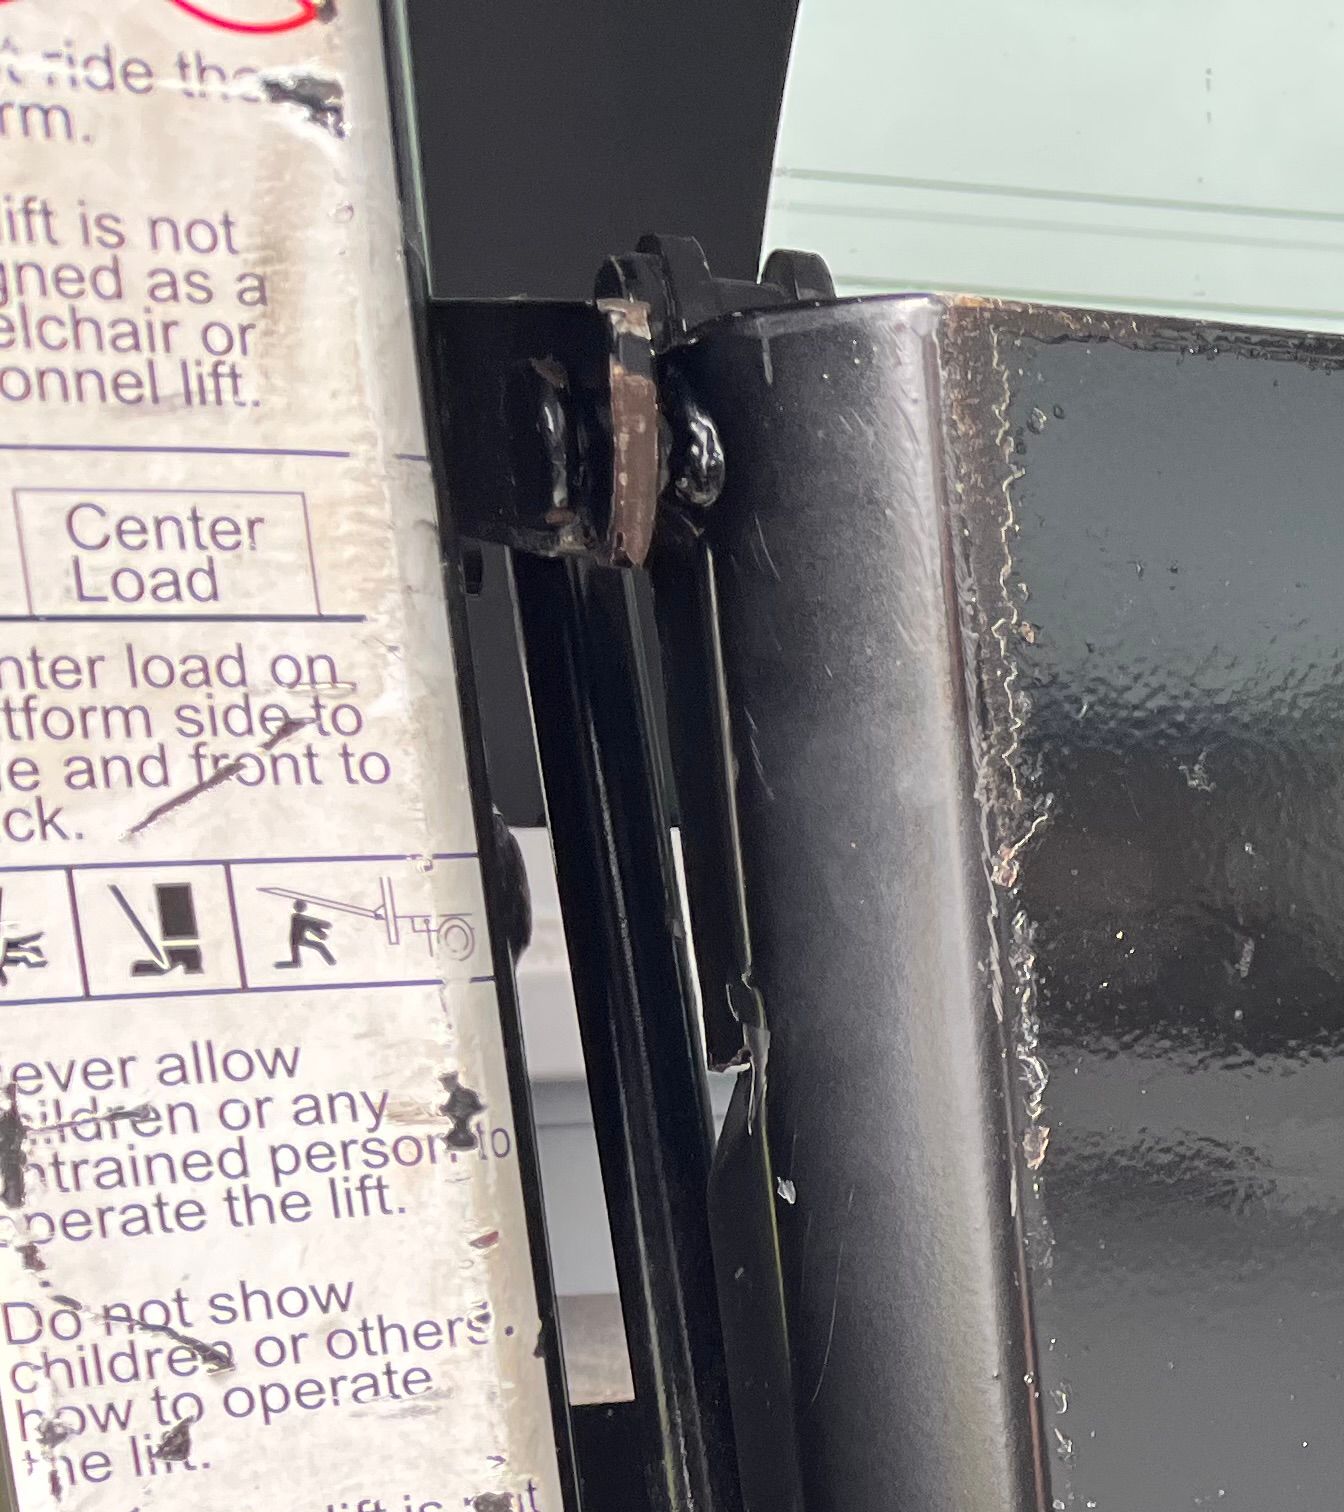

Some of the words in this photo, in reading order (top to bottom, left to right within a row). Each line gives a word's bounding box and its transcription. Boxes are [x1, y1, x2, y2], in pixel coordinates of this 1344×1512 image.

[78, 199, 126, 249] is
[149, 209, 239, 255] not
[147, 267, 214, 305] as
[236, 271, 268, 307] a
[201, 320, 256, 357] or
[180, 358, 261, 407] lift.
[66, 502, 265, 552] Center
[73, 555, 220, 603] Load
[126, 642, 249, 689] load
[271, 653, 339, 689] on
[176, 693, 291, 738] side
[312, 699, 363, 737] to
[64, 742, 170, 790] and
[188, 743, 321, 787] front
[338, 743, 391, 785] to
[157, 1040, 300, 1087] allow
[219, 1096, 273, 1131] or
[293, 1088, 390, 1132] any
[223, 1184, 311, 1227] the
[329, 1174, 406, 1220] lift.
[2, 1301, 82, 1345] Do
[103, 1288, 193, 1336] not
[210, 1280, 353, 1325] show
[255, 1330, 307, 1368] or
[151, 1386, 204, 1425] to
[223, 1363, 434, 1426] operate
